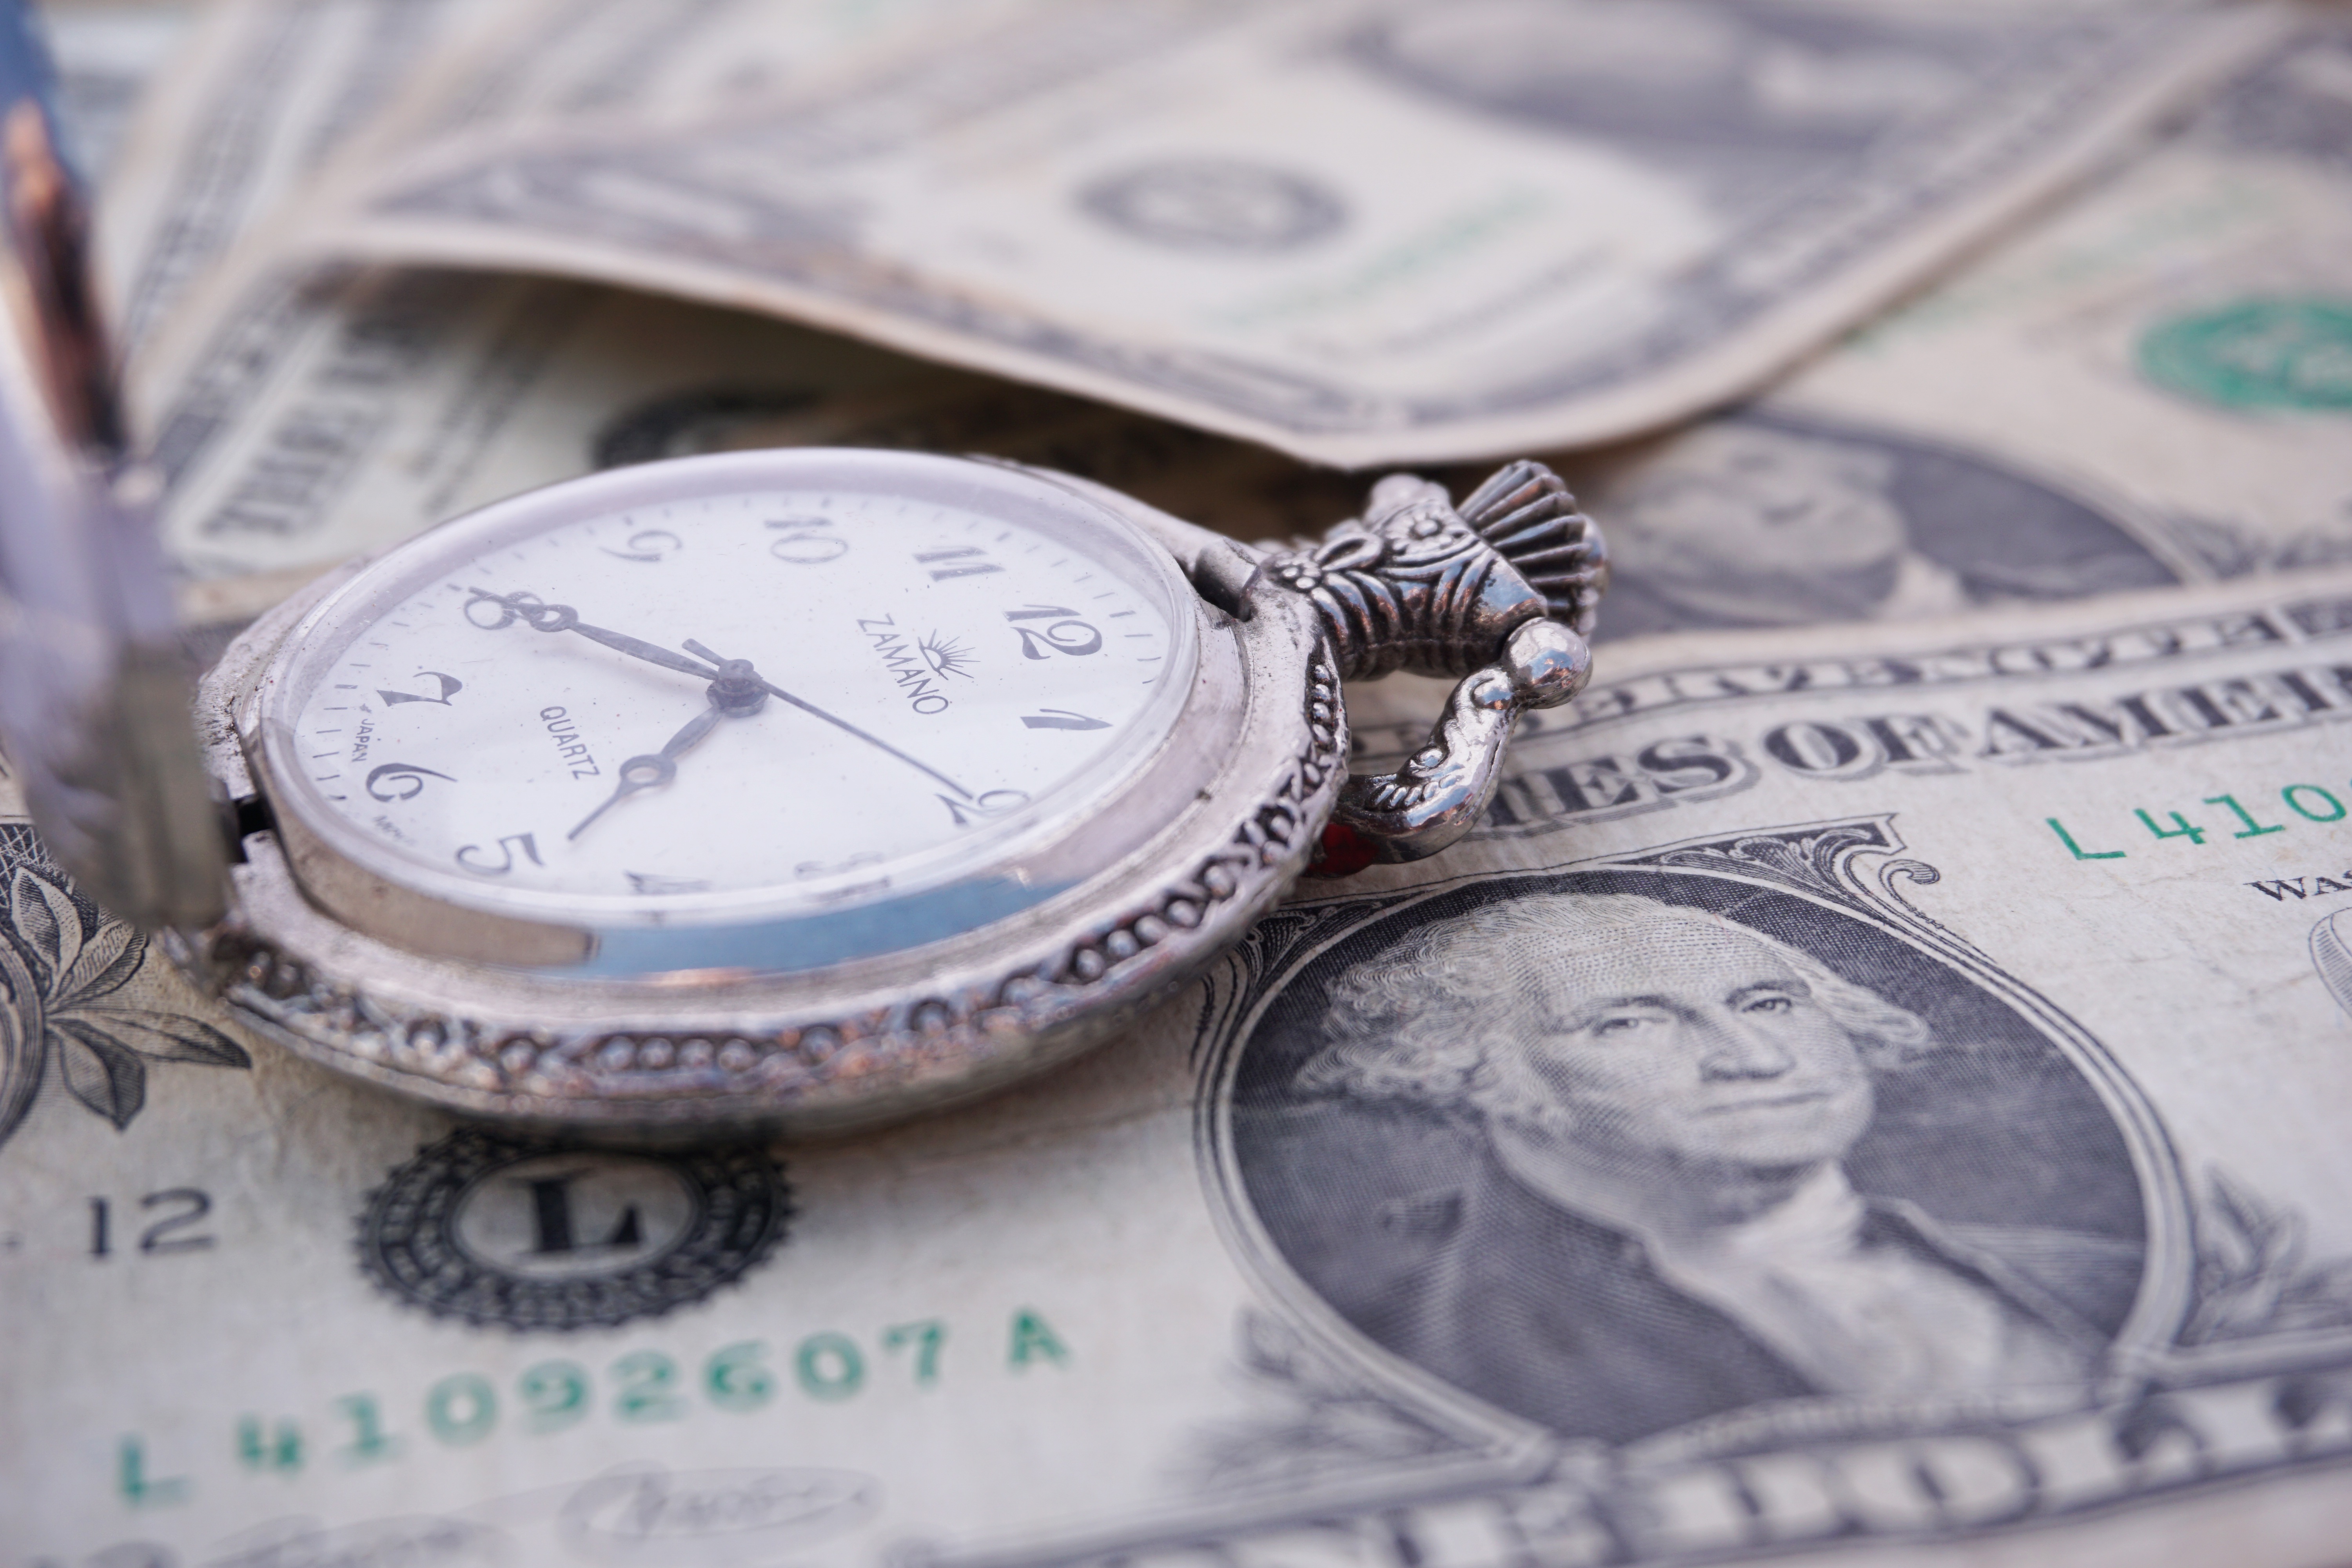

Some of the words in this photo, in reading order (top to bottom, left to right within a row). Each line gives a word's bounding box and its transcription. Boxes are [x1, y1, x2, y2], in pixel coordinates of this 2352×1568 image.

[597, 530, 682, 562] 9
[764, 517, 848, 564] 10
[912, 548, 1005, 582] 11
[464, 592, 544, 630] 8
[1003, 604, 1102, 660] 12
[857, 614, 948, 714] ZAMANO
[376, 671, 463, 706] 7
[352, 718, 373, 762] JAPAN
[1020, 708, 1113, 730] 1
[540, 707, 600, 780] QUARTZ
[1762, 714, 1968, 778] OF
[366, 763, 457, 802] 6
[936, 789, 1032, 825] 2
[2045, 817, 2126, 860] L
[2133, 774, 2352, 845] 410
[456, 833, 545, 876] 5
[90, 1187, 216, 1261] 12
[517, 1177, 641, 1254] L
[118, 1431, 196, 1509] L
[1005, 1305, 1072, 1374] A
